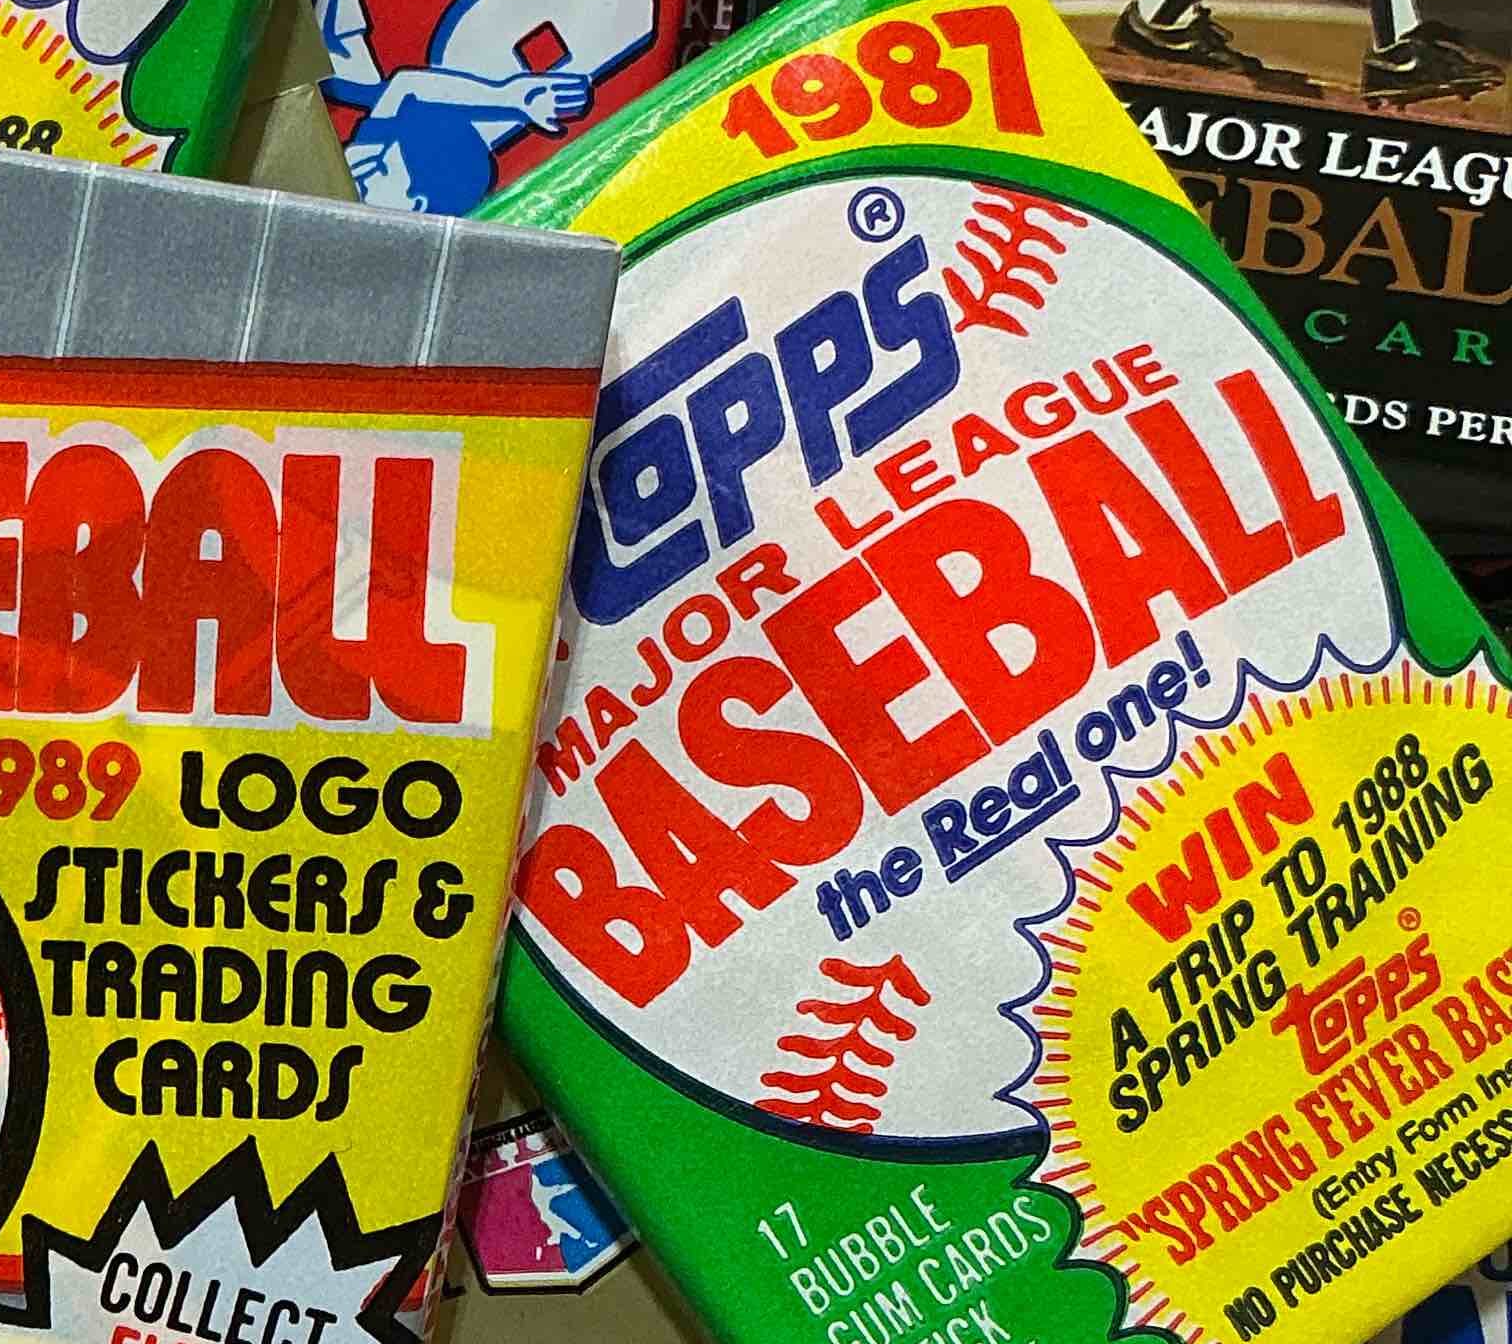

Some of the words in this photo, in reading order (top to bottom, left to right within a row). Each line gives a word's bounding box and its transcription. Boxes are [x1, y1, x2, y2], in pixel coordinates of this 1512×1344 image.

[721, 3, 1045, 161] 1987
[535, 540, 803, 798] MAJOR
[813, 341, 1179, 549] LEAGUE
[519, 365, 1348, 1006] BASEBALL
[177, 750, 466, 837] LOGO
[816, 848, 923, 943] the
[921, 751, 1081, 884] Real
[1073, 629, 1210, 761] one!
[1126, 751, 1315, 945] WIN
[24, 843, 402, 936] STICKERS
[412, 859, 476, 939] &
[1108, 948, 1287, 1134] SPRING
[1285, 742, 1494, 970] TRAINING
[1110, 1006, 1149, 1074] A
[1147, 898, 1255, 1024] TRIP
[1260, 835, 1328, 919] TO
[1331, 732, 1430, 853] 1988
[39, 939, 434, 1034] TRADING
[92, 1037, 364, 1125] CARDS
[1295, 1021, 1456, 1163] FEVER
[1312, 1145, 1398, 1222] (Entry
[1396, 1089, 1479, 1157] Form
[756, 1201, 812, 1261] 17
[790, 1182, 952, 1317] BUBBLE
[913, 1194, 1055, 1307] CARDS
[1223, 1285, 1278, 1343] NO
[1270, 1182, 1425, 1310] PURCHASE
